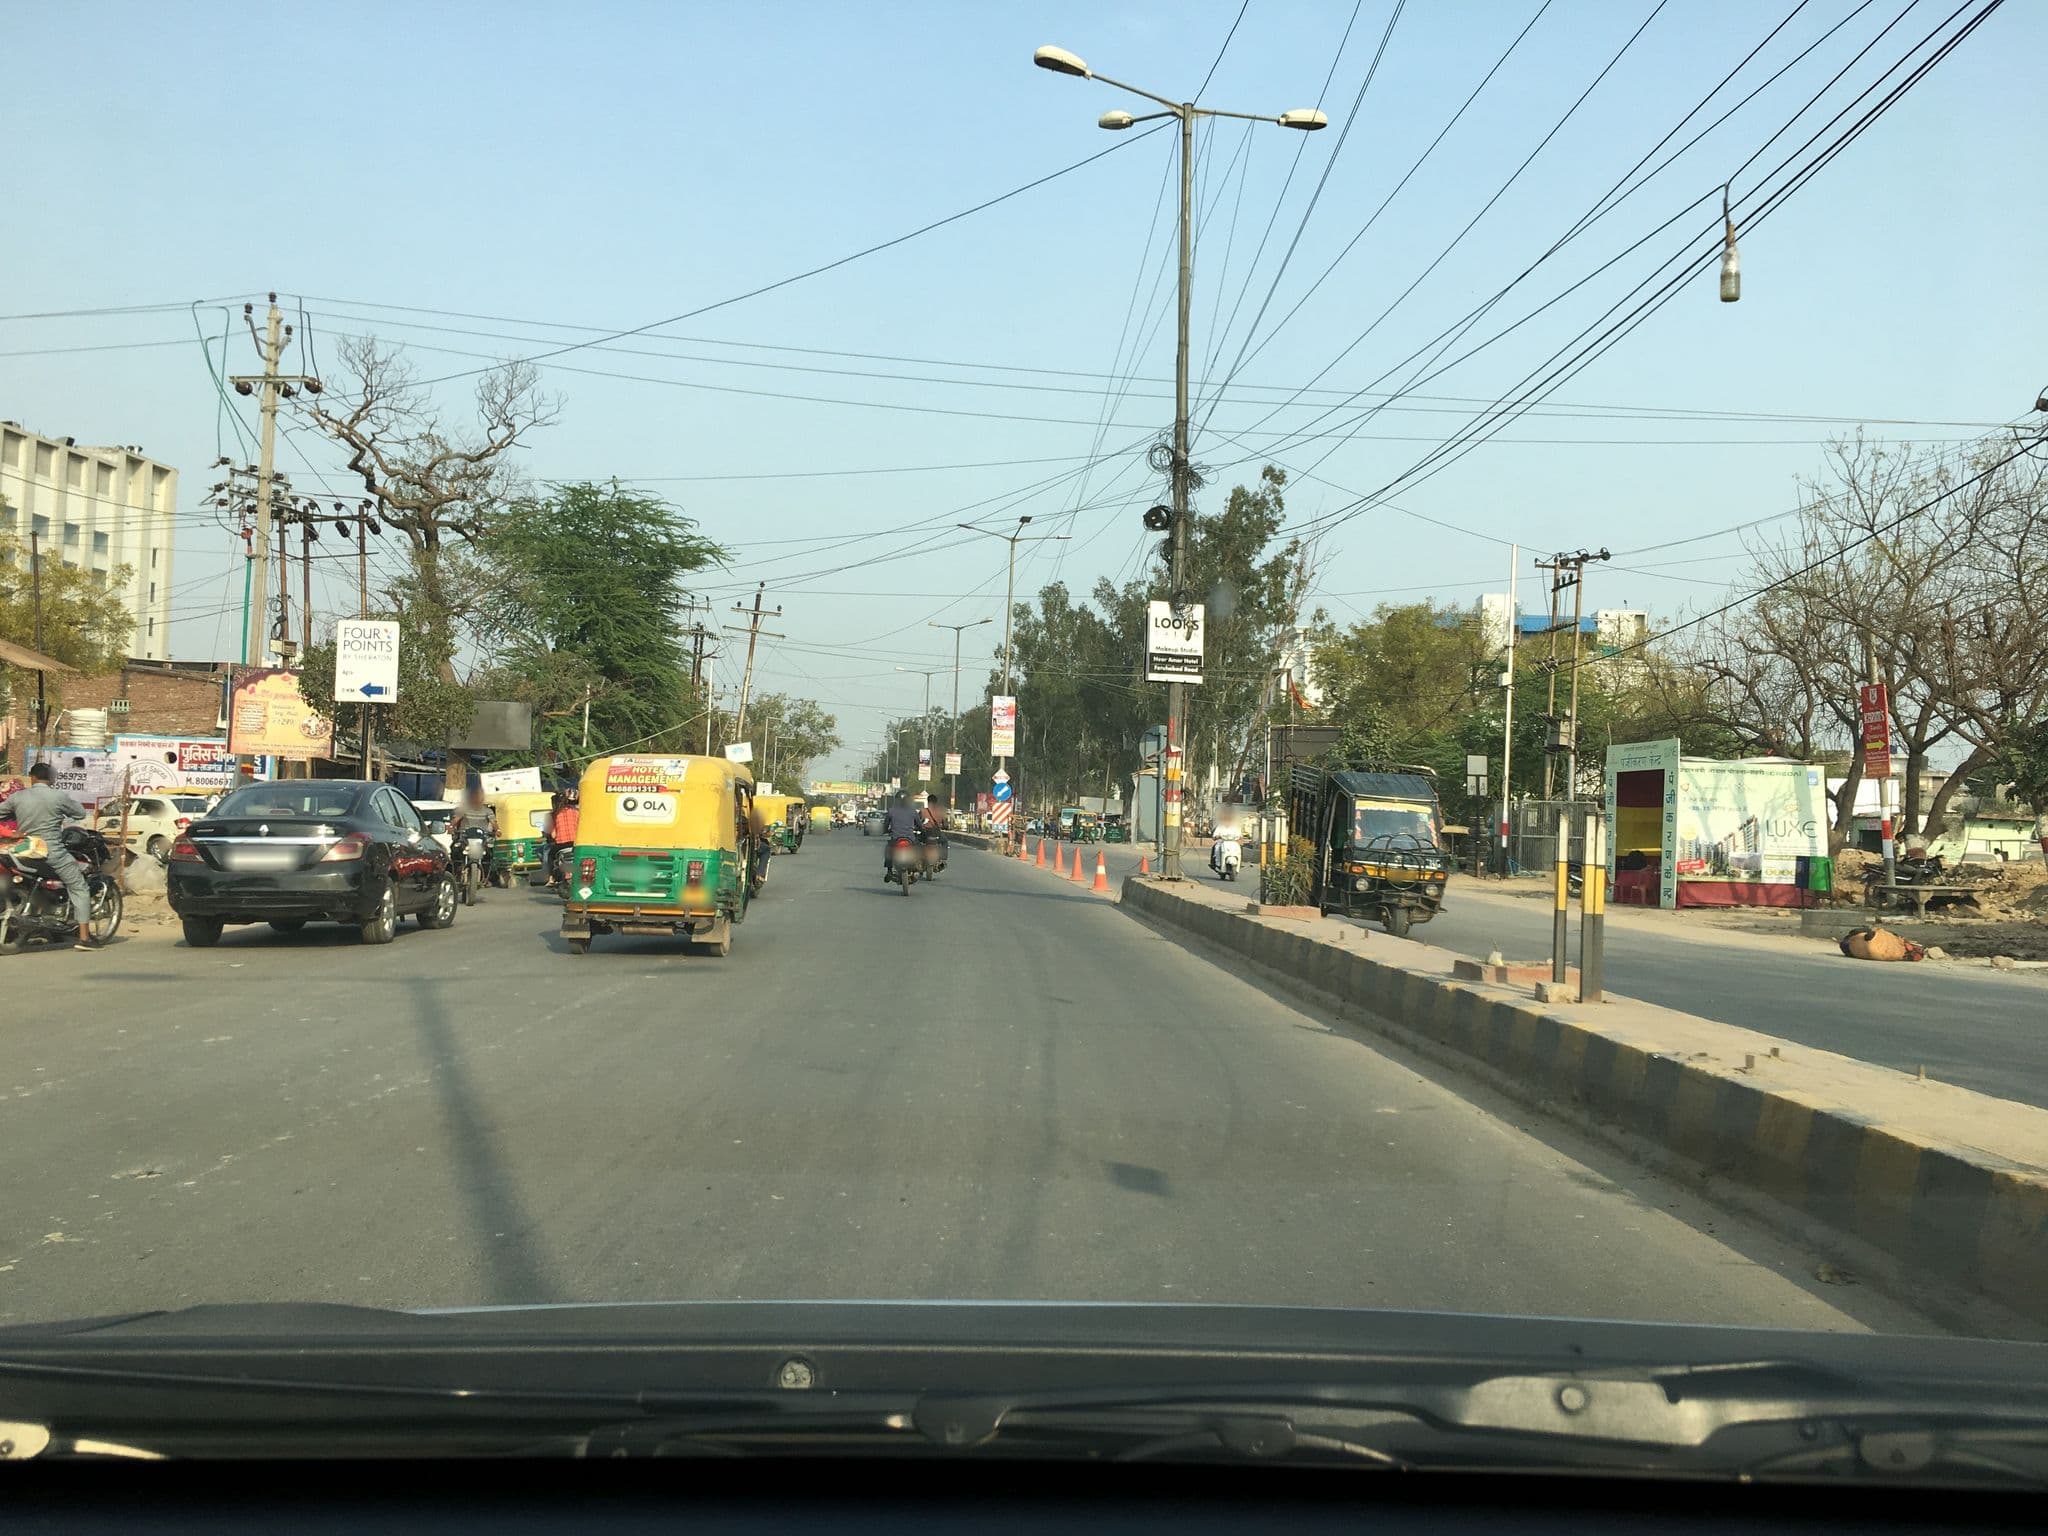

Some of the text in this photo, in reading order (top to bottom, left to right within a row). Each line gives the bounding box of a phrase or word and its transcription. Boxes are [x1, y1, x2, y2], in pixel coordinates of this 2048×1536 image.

[343, 627, 381, 640] FOUR
[343, 640, 393, 652] POINTS
[182, 745, 211, 763] पुलिस
[643, 801, 667, 811] OLA
[1766, 819, 1818, 839] LUXE
